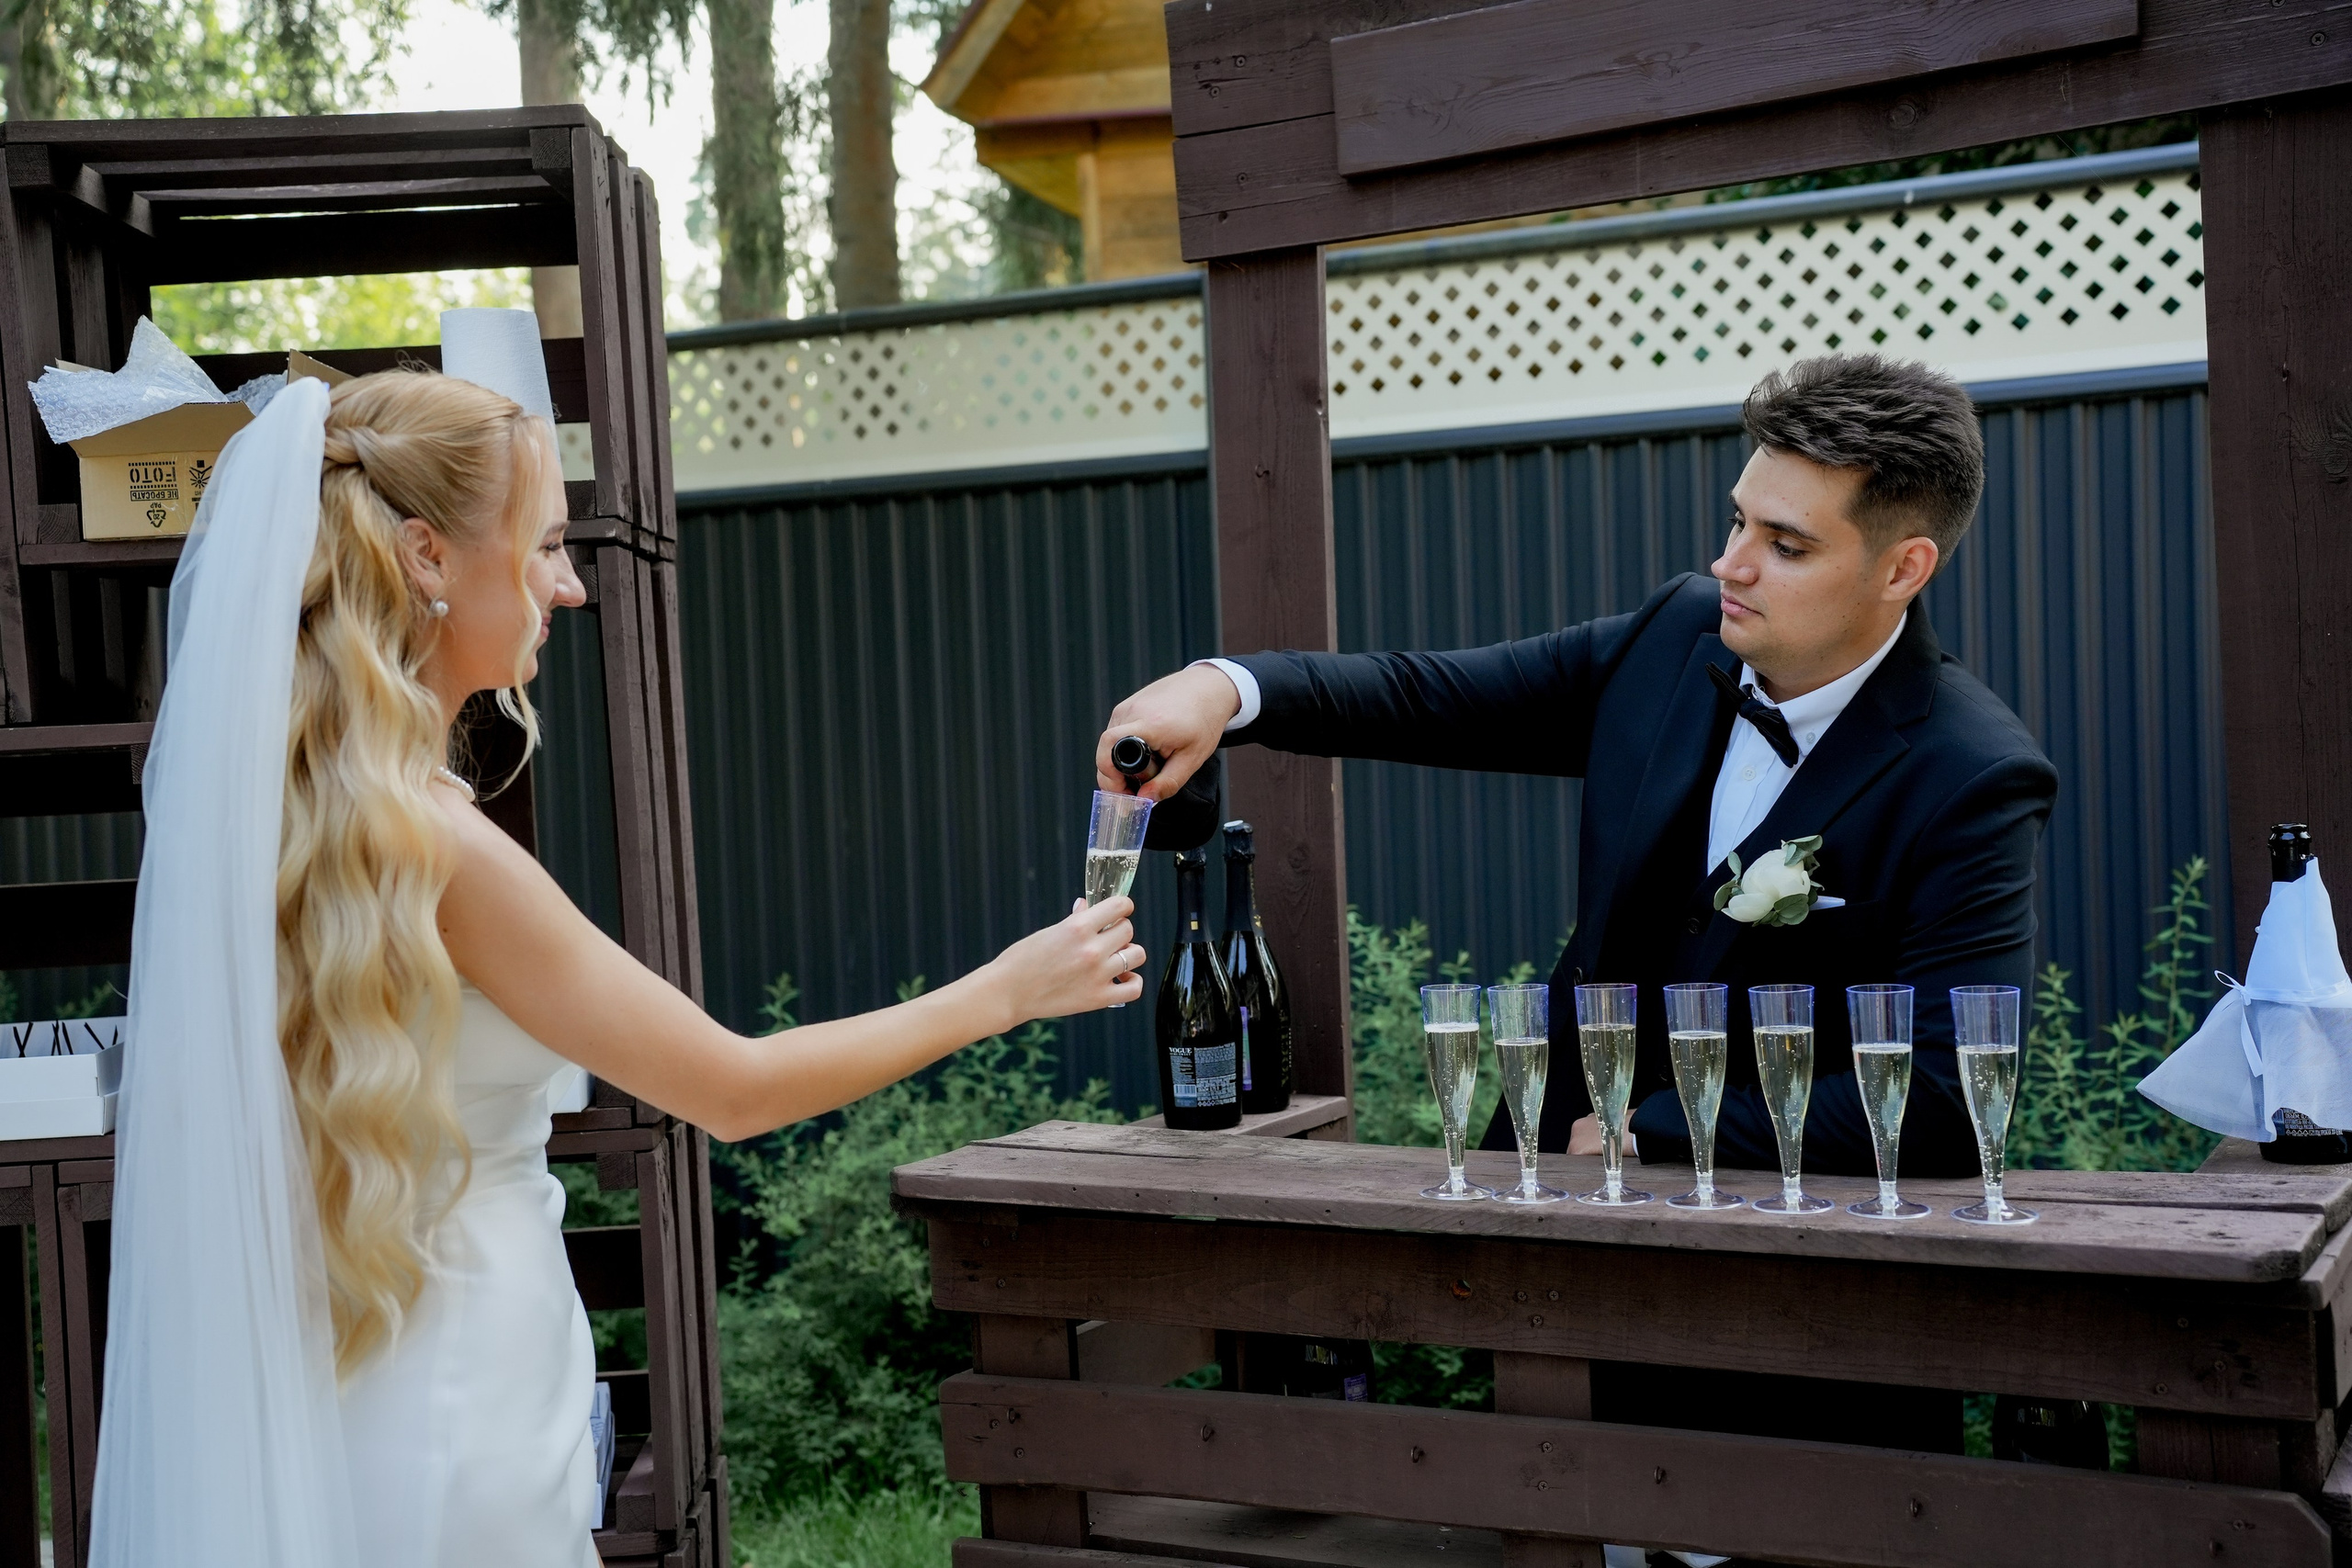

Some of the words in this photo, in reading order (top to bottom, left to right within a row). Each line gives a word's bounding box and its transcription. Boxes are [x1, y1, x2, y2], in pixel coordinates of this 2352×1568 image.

[130, 467, 176, 483] FOTO
[131, 491, 165, 500] БРОСАТЬ
[167, 491, 177, 499] НЕ
